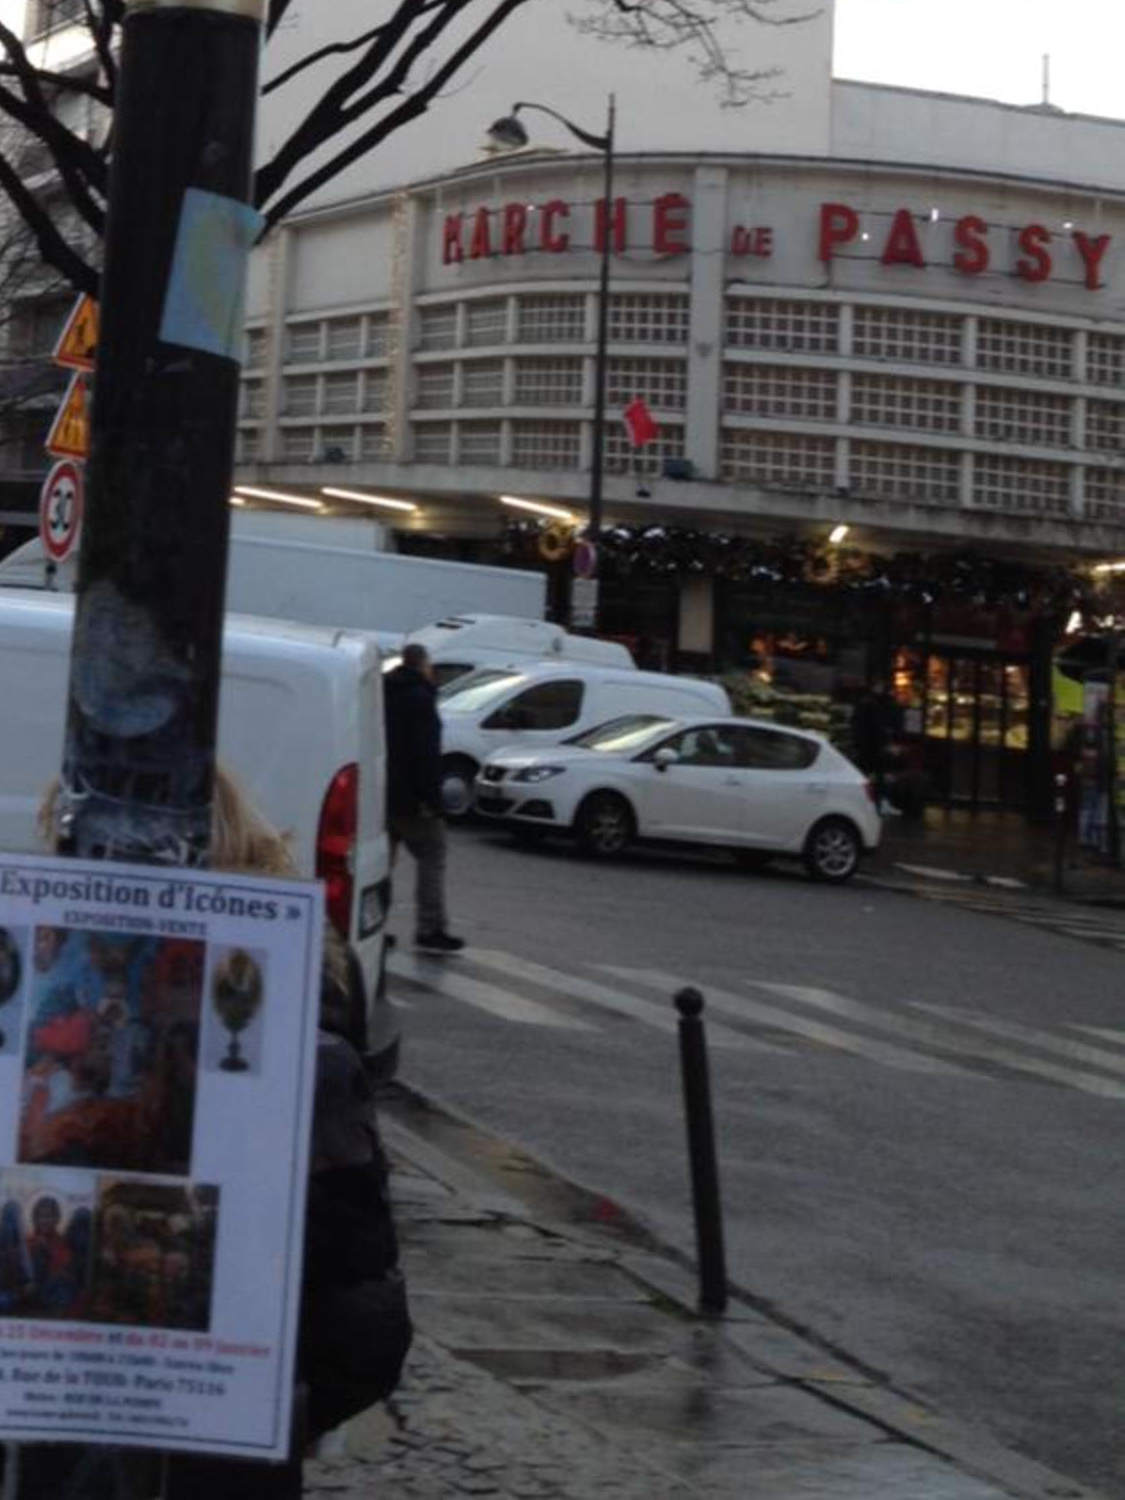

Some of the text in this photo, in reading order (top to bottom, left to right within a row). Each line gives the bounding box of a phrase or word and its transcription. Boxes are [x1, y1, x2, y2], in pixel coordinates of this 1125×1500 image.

[730, 225, 772, 258] DE
[818, 203, 1110, 291] PASSY
[0, 869, 150, 907] Exposition
